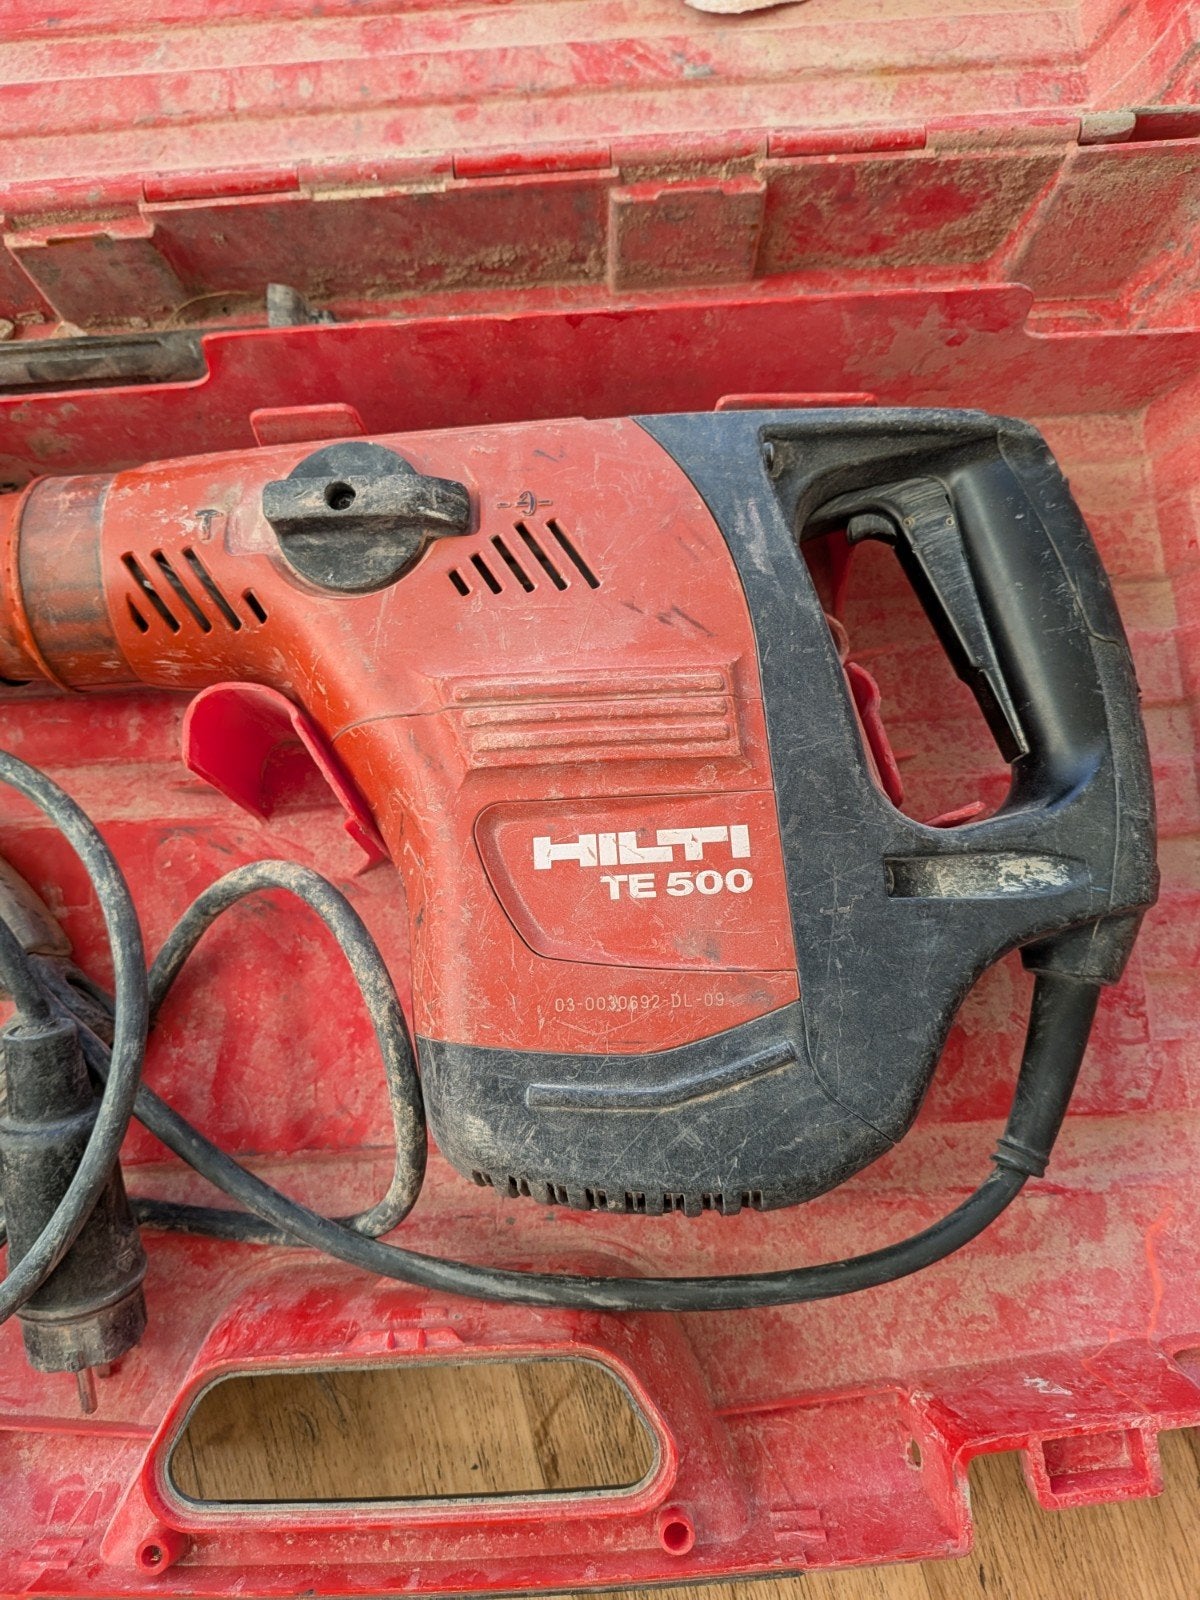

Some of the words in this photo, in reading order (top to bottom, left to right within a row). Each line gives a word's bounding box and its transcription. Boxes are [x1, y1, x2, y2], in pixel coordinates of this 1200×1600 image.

[533, 824, 751, 870] HILTI
[600, 873, 657, 900] TE
[666, 868, 754, 897] 500
